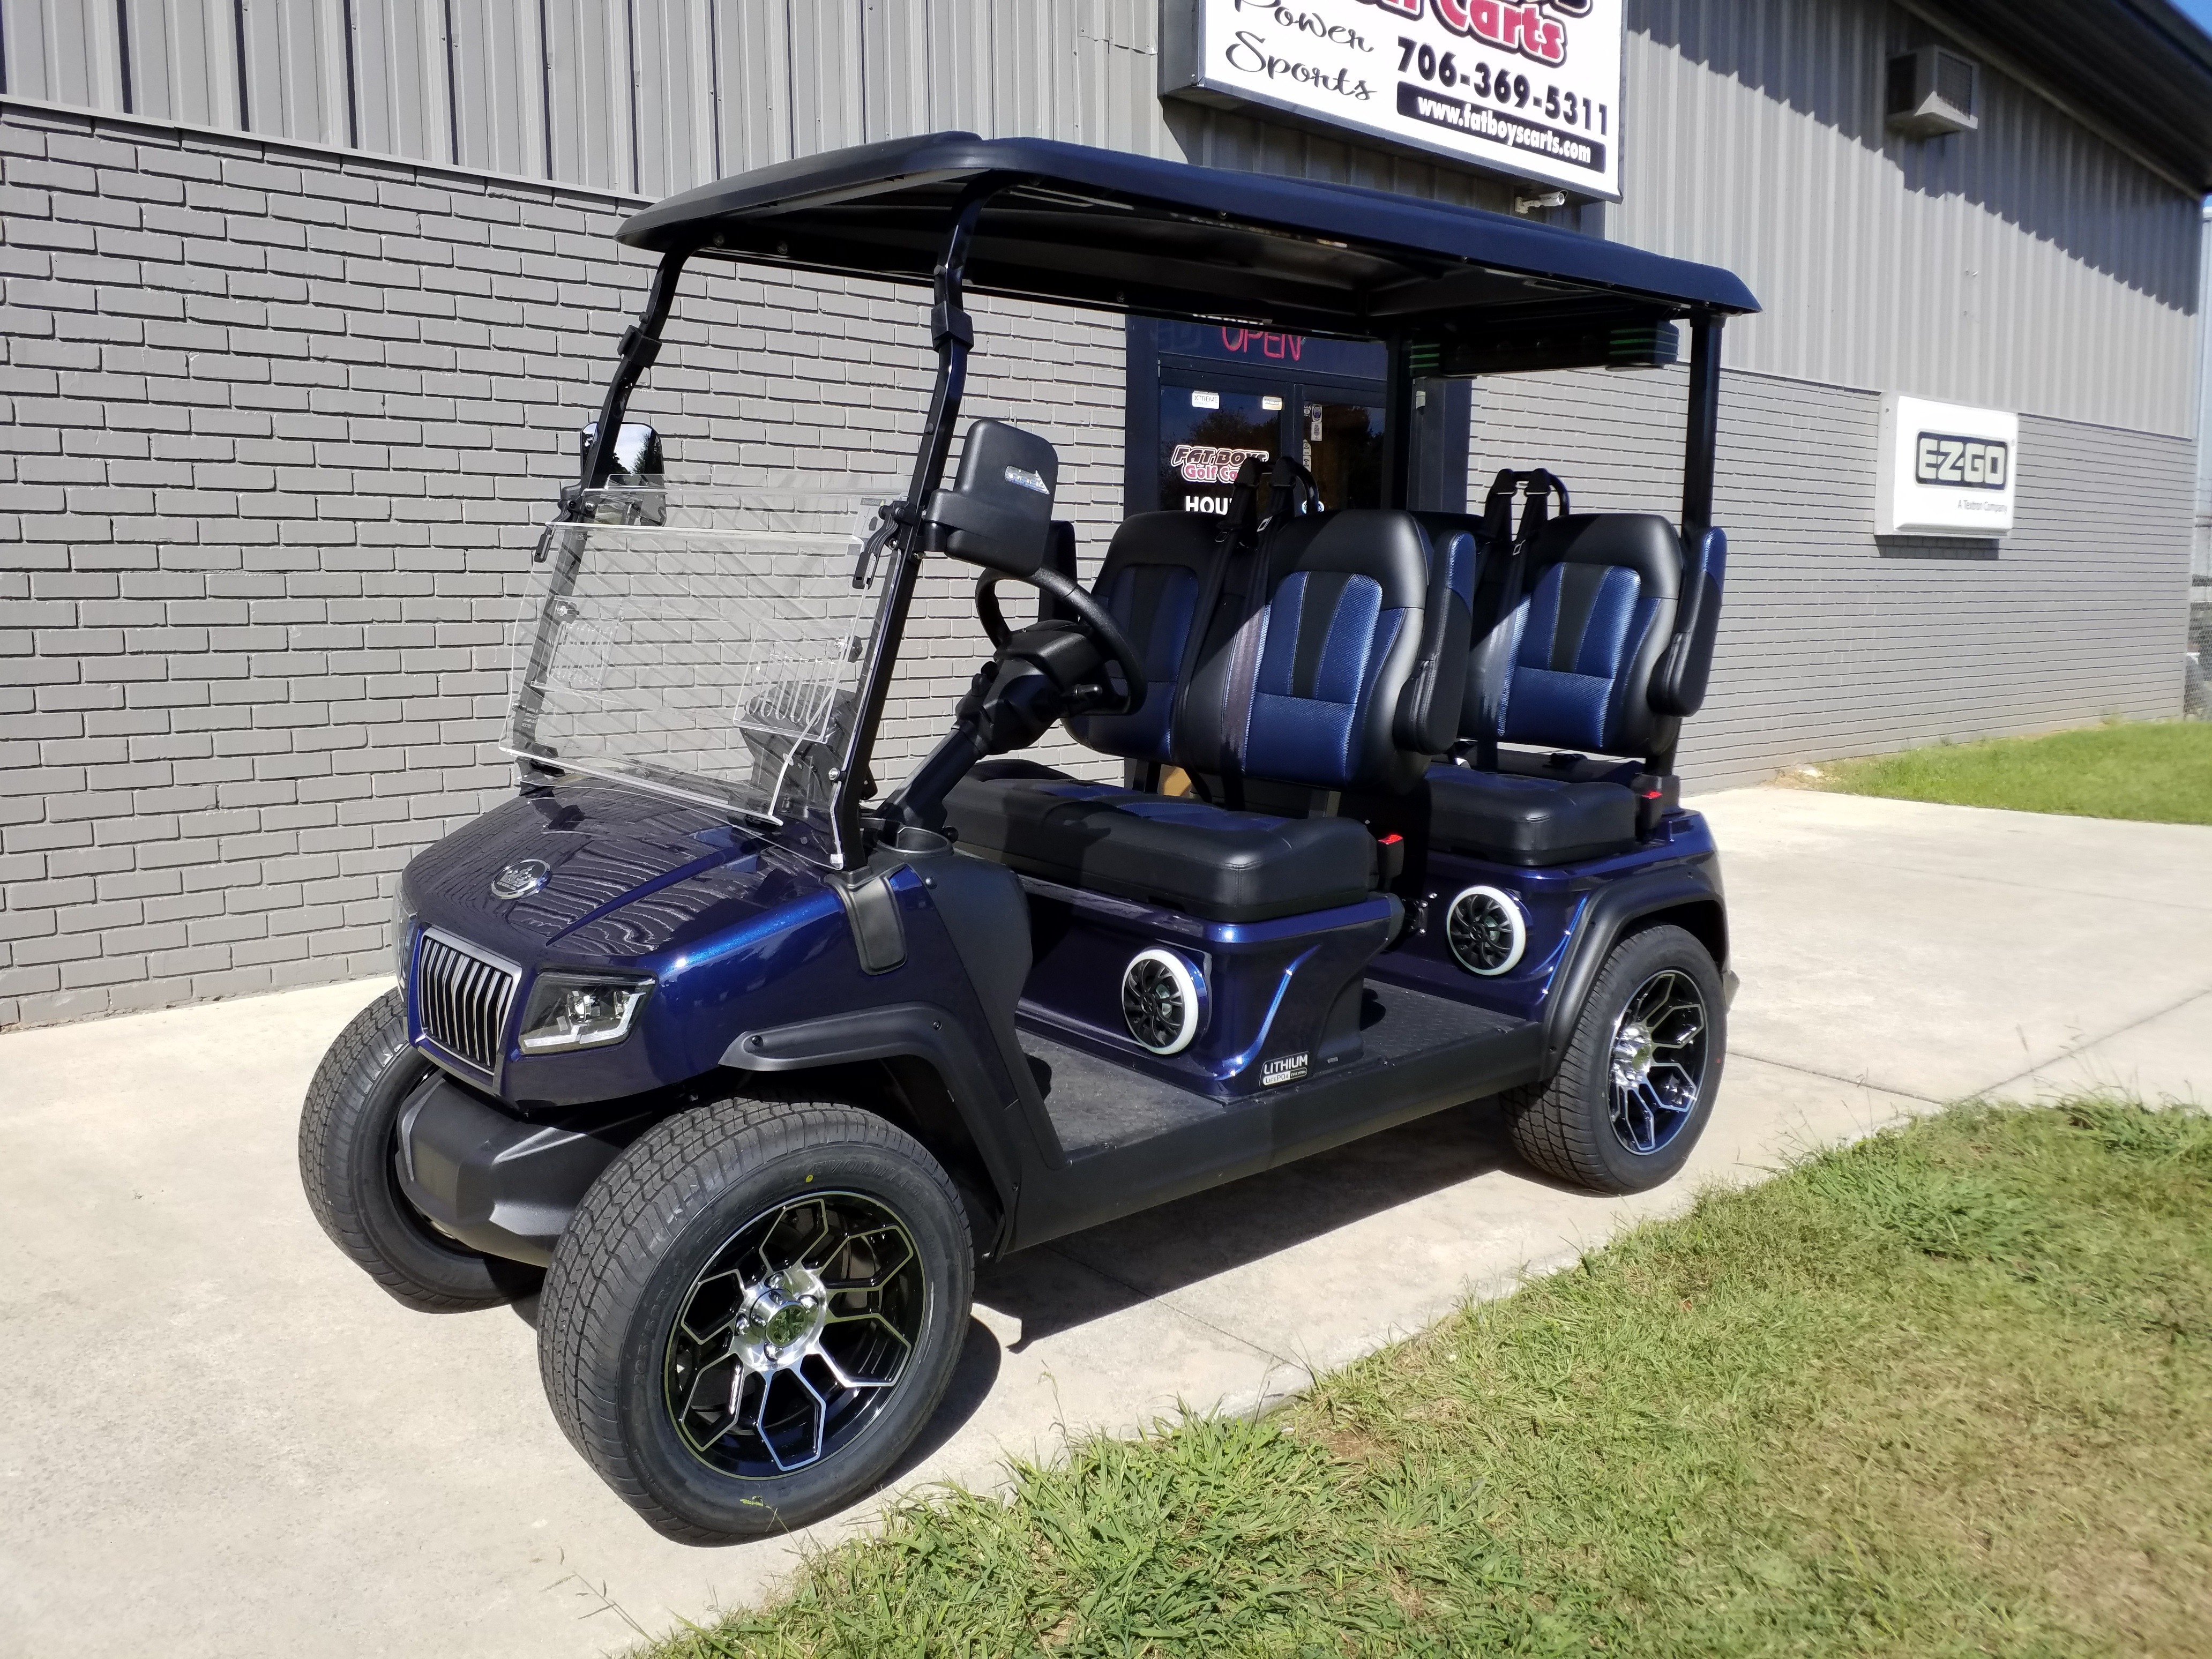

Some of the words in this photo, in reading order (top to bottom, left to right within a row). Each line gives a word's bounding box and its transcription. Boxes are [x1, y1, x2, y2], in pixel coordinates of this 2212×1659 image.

[1234, 0, 1374, 53] ower
[1225, 30, 1379, 101] Sports
[1397, 35, 1608, 137] 706-369-5311
[1417, 95, 1592, 164] www.fatboyscarts.com
[1222, 326, 1301, 361] OPEN
[1194, 394, 1218, 403] XTREME
[1174, 447, 1215, 465] FAT
[1185, 465, 1217, 480] Golf
[1185, 496, 1232, 515] HOU
[1264, 1053, 1308, 1075] LITHIUM
